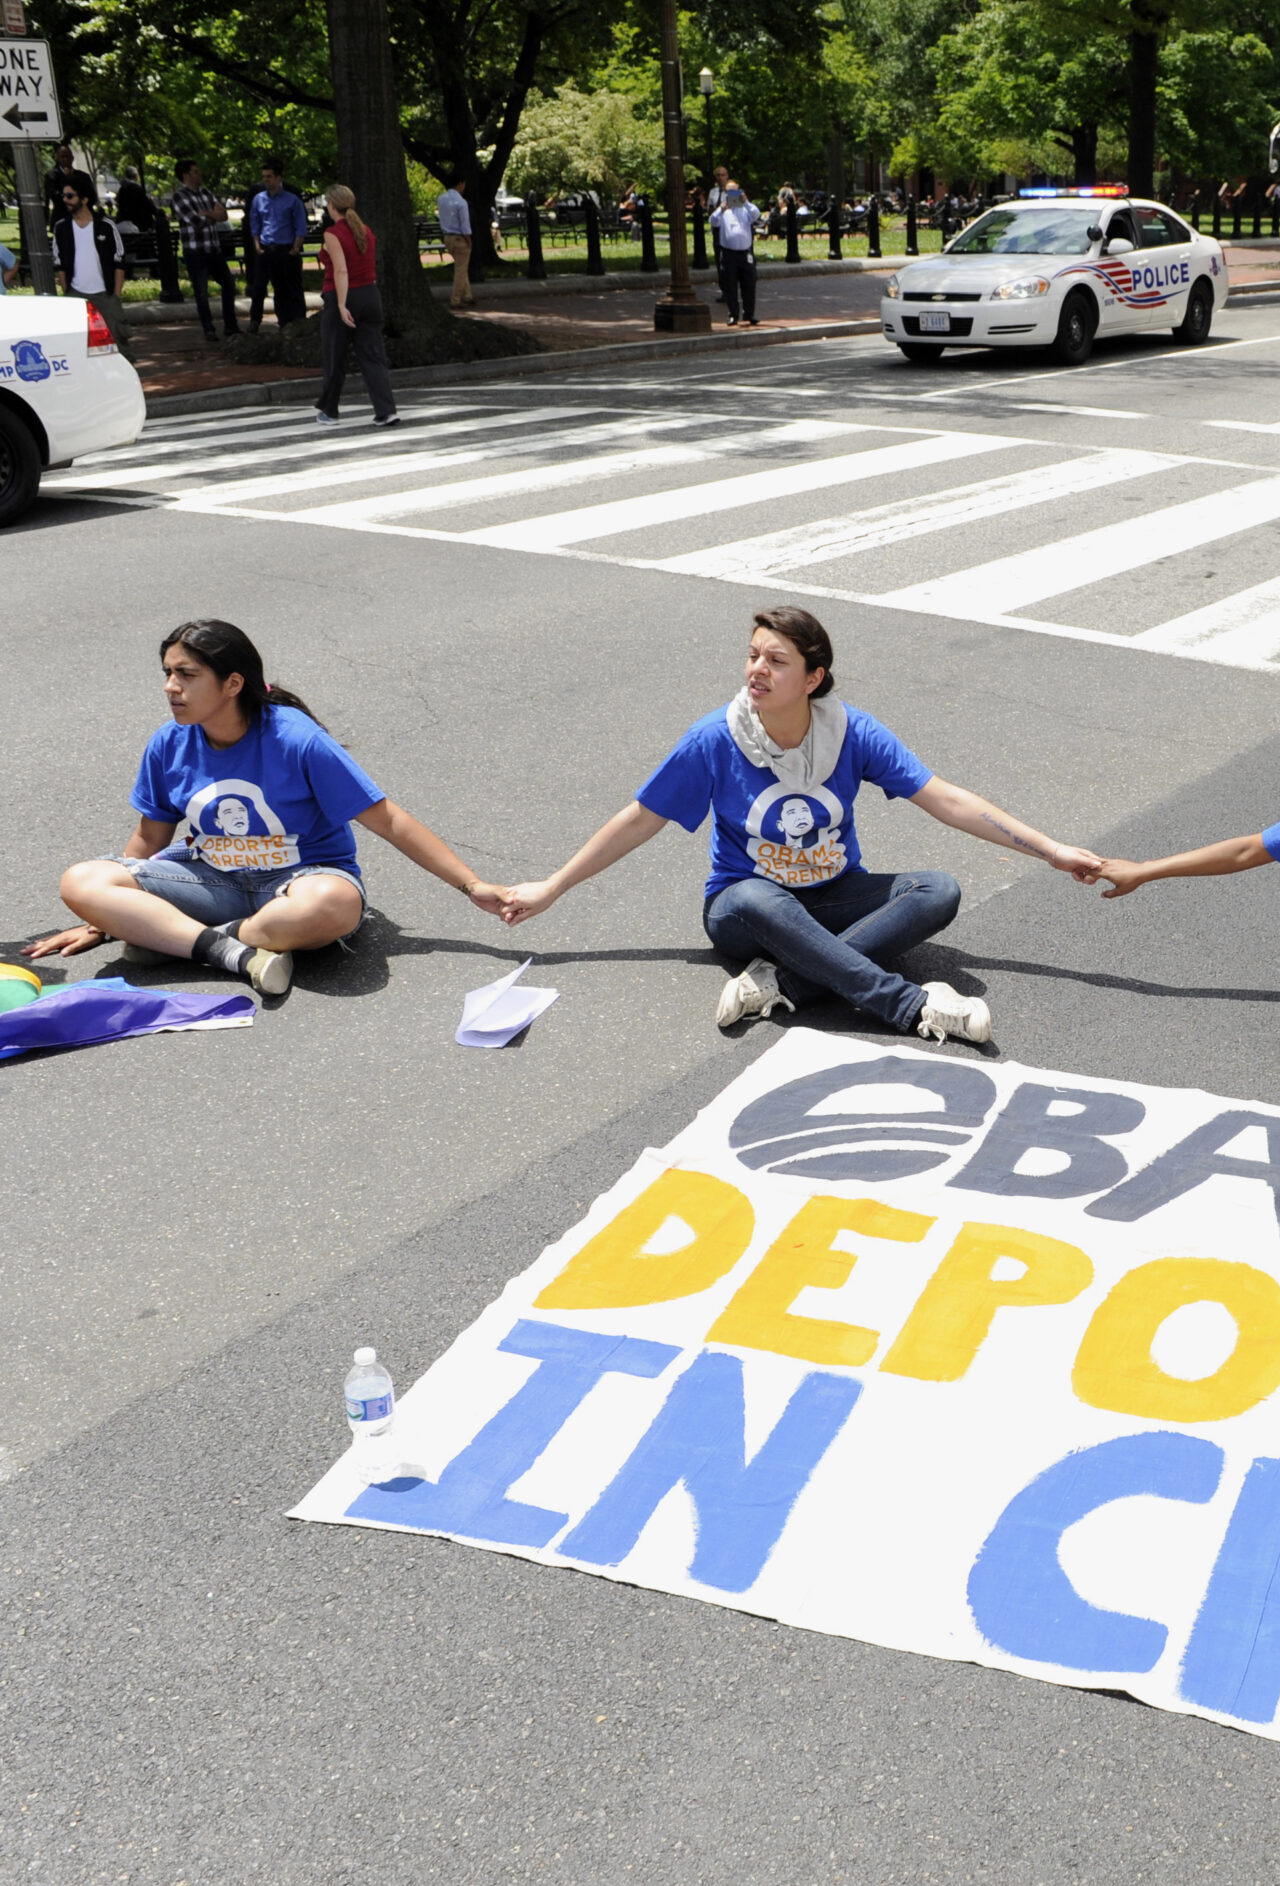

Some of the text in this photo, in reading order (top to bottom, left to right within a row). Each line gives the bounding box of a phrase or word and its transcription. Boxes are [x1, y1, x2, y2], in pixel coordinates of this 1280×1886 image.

[0, 49, 40, 71] ONE
[0, 75, 42, 97] WAY
[1132, 263, 1190, 291] POLICE
[52, 359, 70, 372] DC
[346, 1321, 862, 1592] IN
